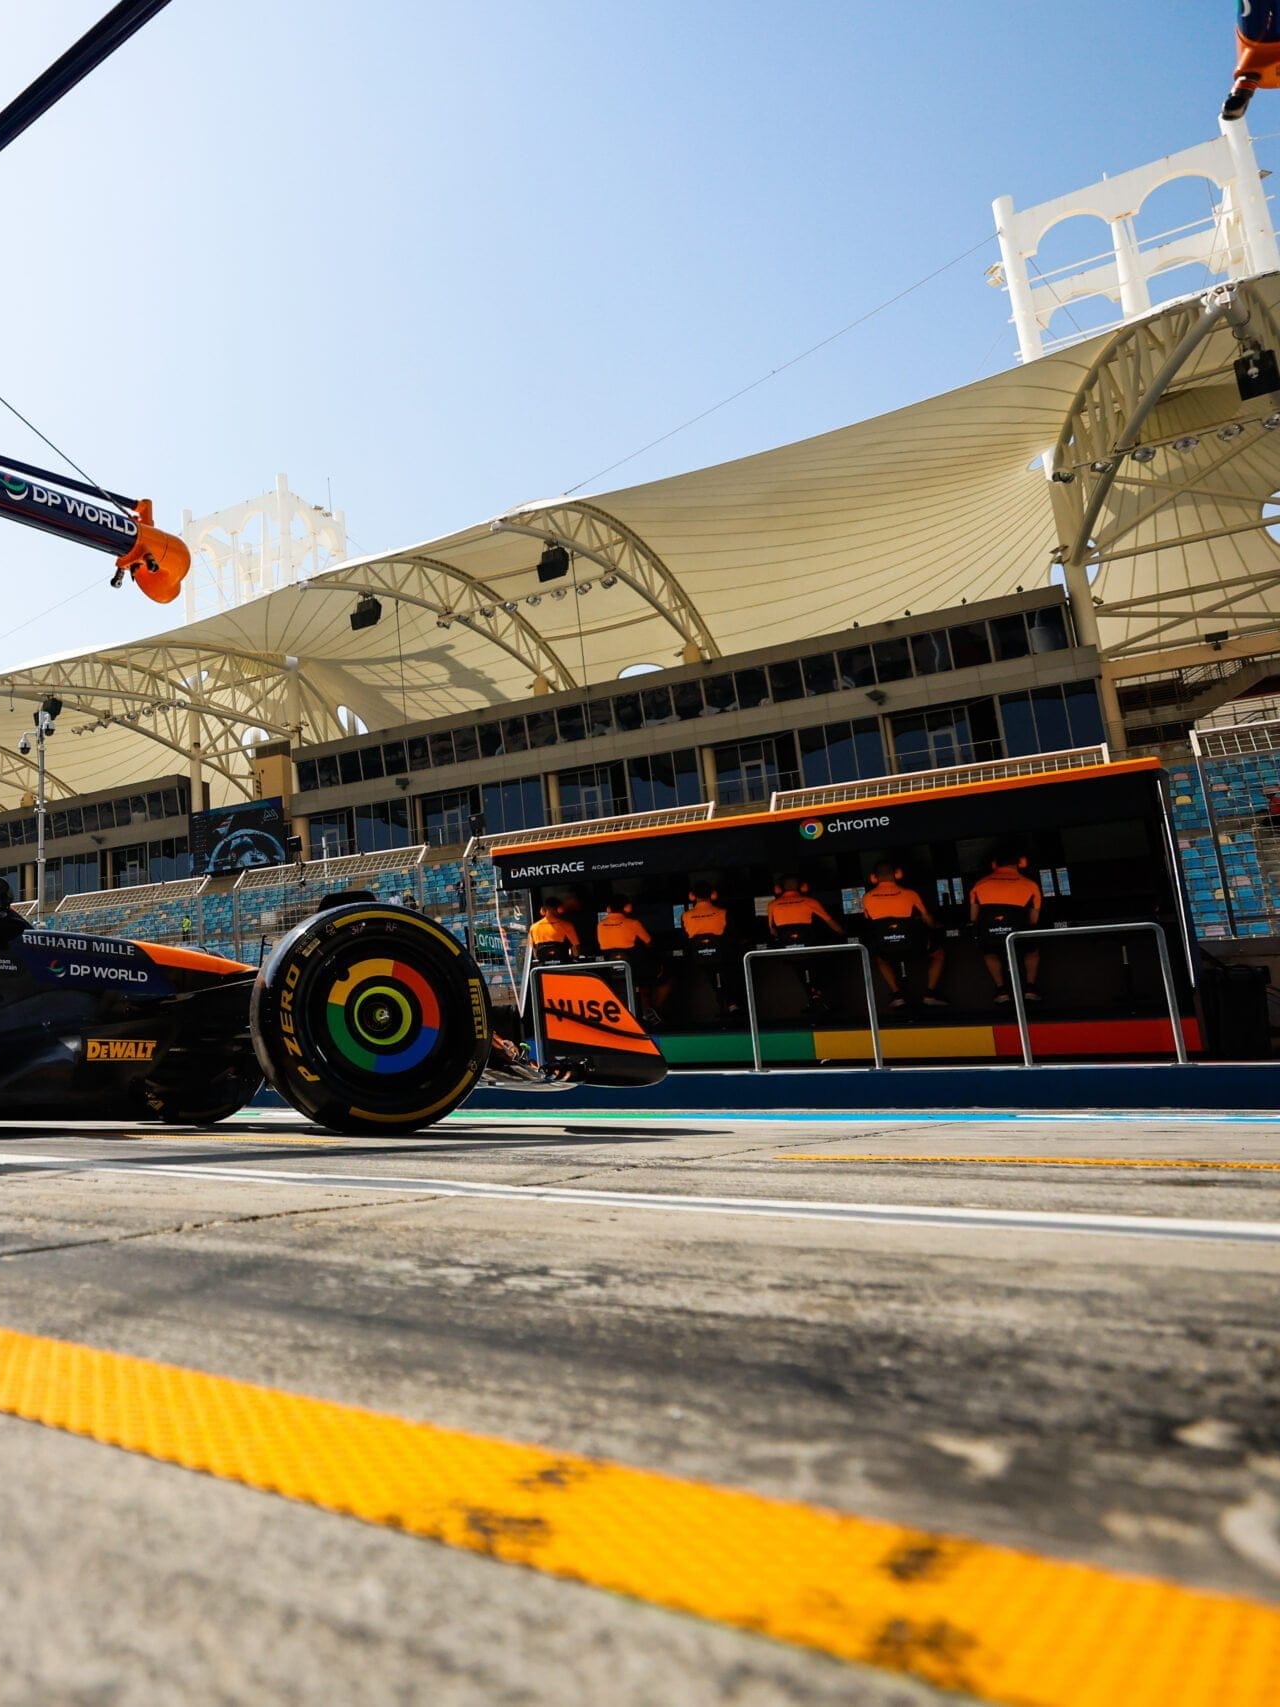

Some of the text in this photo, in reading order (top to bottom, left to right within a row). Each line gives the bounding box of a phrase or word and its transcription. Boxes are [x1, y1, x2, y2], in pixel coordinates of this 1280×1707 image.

[31, 484, 138, 536] DP WORLD
[827, 815, 891, 833] chrome
[510, 860, 585, 879] DARKTRACE
[22, 934, 136, 956] RICHARD MILLE
[69, 963, 149, 983] DP WORLD
[467, 977, 489, 1040] PIRELLI
[279, 963, 322, 1083] P ZERO
